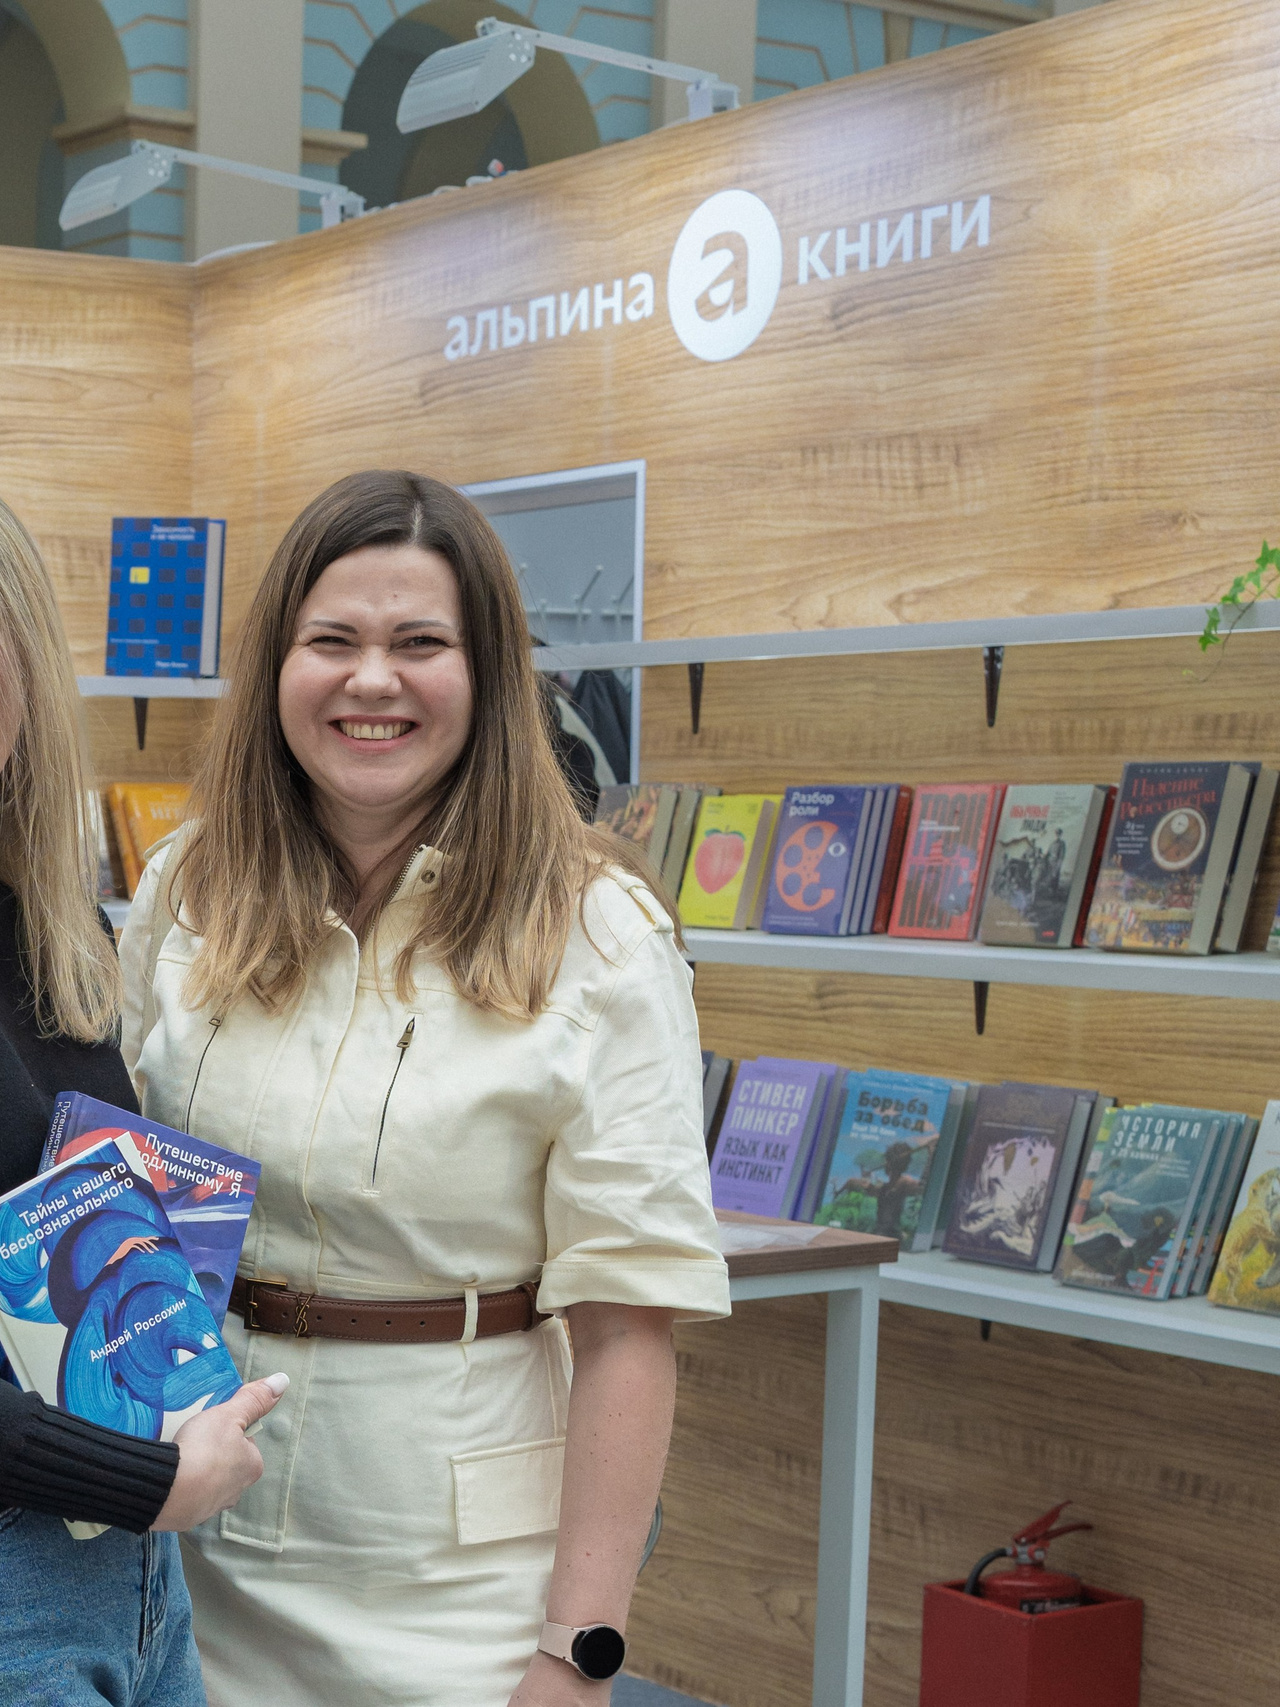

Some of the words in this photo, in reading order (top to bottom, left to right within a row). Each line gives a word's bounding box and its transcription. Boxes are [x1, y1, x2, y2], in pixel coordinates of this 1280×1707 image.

[443, 273, 655, 362] альпина
[797, 195, 992, 285] книги
[789, 805, 819, 817] роли
[791, 791, 835, 806] Разбор
[738, 1079, 807, 1110] СТИВЕН
[858, 1091, 928, 1115] Борьба
[49, 1101, 71, 1167] Путешествие
[730, 1105, 800, 1136] ПИНКЕР
[1122, 1115, 1201, 1139] ИСТОРИЯ
[41, 1112, 60, 1172] подлинному
[723, 1137, 760, 1158] ЯЗЫК
[762, 1142, 789, 1163] КАК
[1114, 1131, 1176, 1152] ЗЕМЛИ
[145, 1133, 243, 1182] Путешествие
[718, 1158, 783, 1184] ИНСТИНКТ
[139, 1151, 223, 1194] одлинному
[229, 1182, 242, 1198] Я
[19, 1193, 69, 1227] Тайны
[73, 1162, 127, 1197] нашего
[89, 1331, 133, 1363] Андрей
[134, 1298, 187, 1332] Россохин
